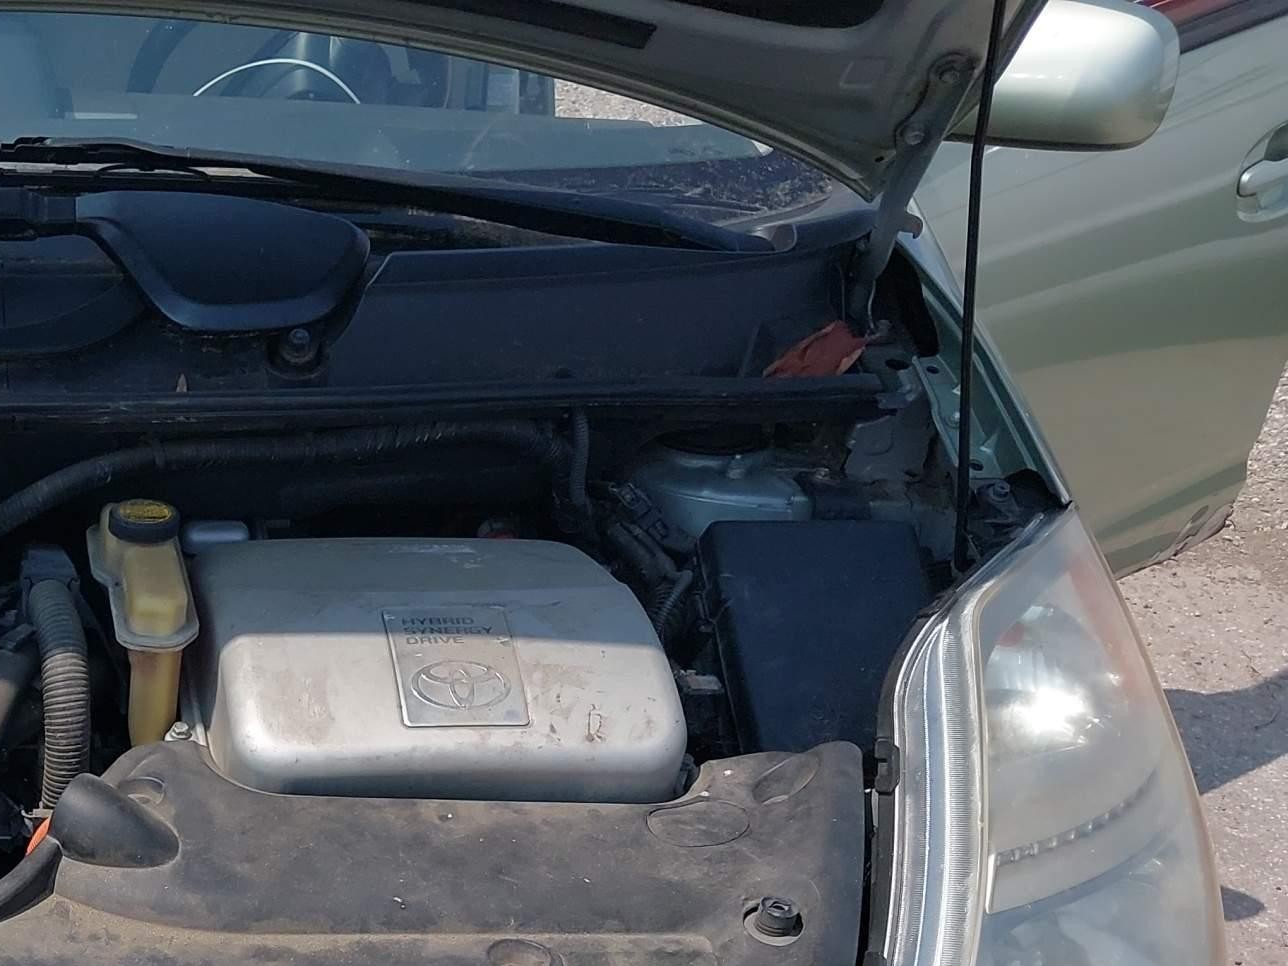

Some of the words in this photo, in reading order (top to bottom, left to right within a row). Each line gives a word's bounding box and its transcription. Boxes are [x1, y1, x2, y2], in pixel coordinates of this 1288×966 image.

[402, 616, 474, 625] HYBRID
[404, 626, 492, 634] SYNERGY
[406, 636, 465, 645] DRIVE
